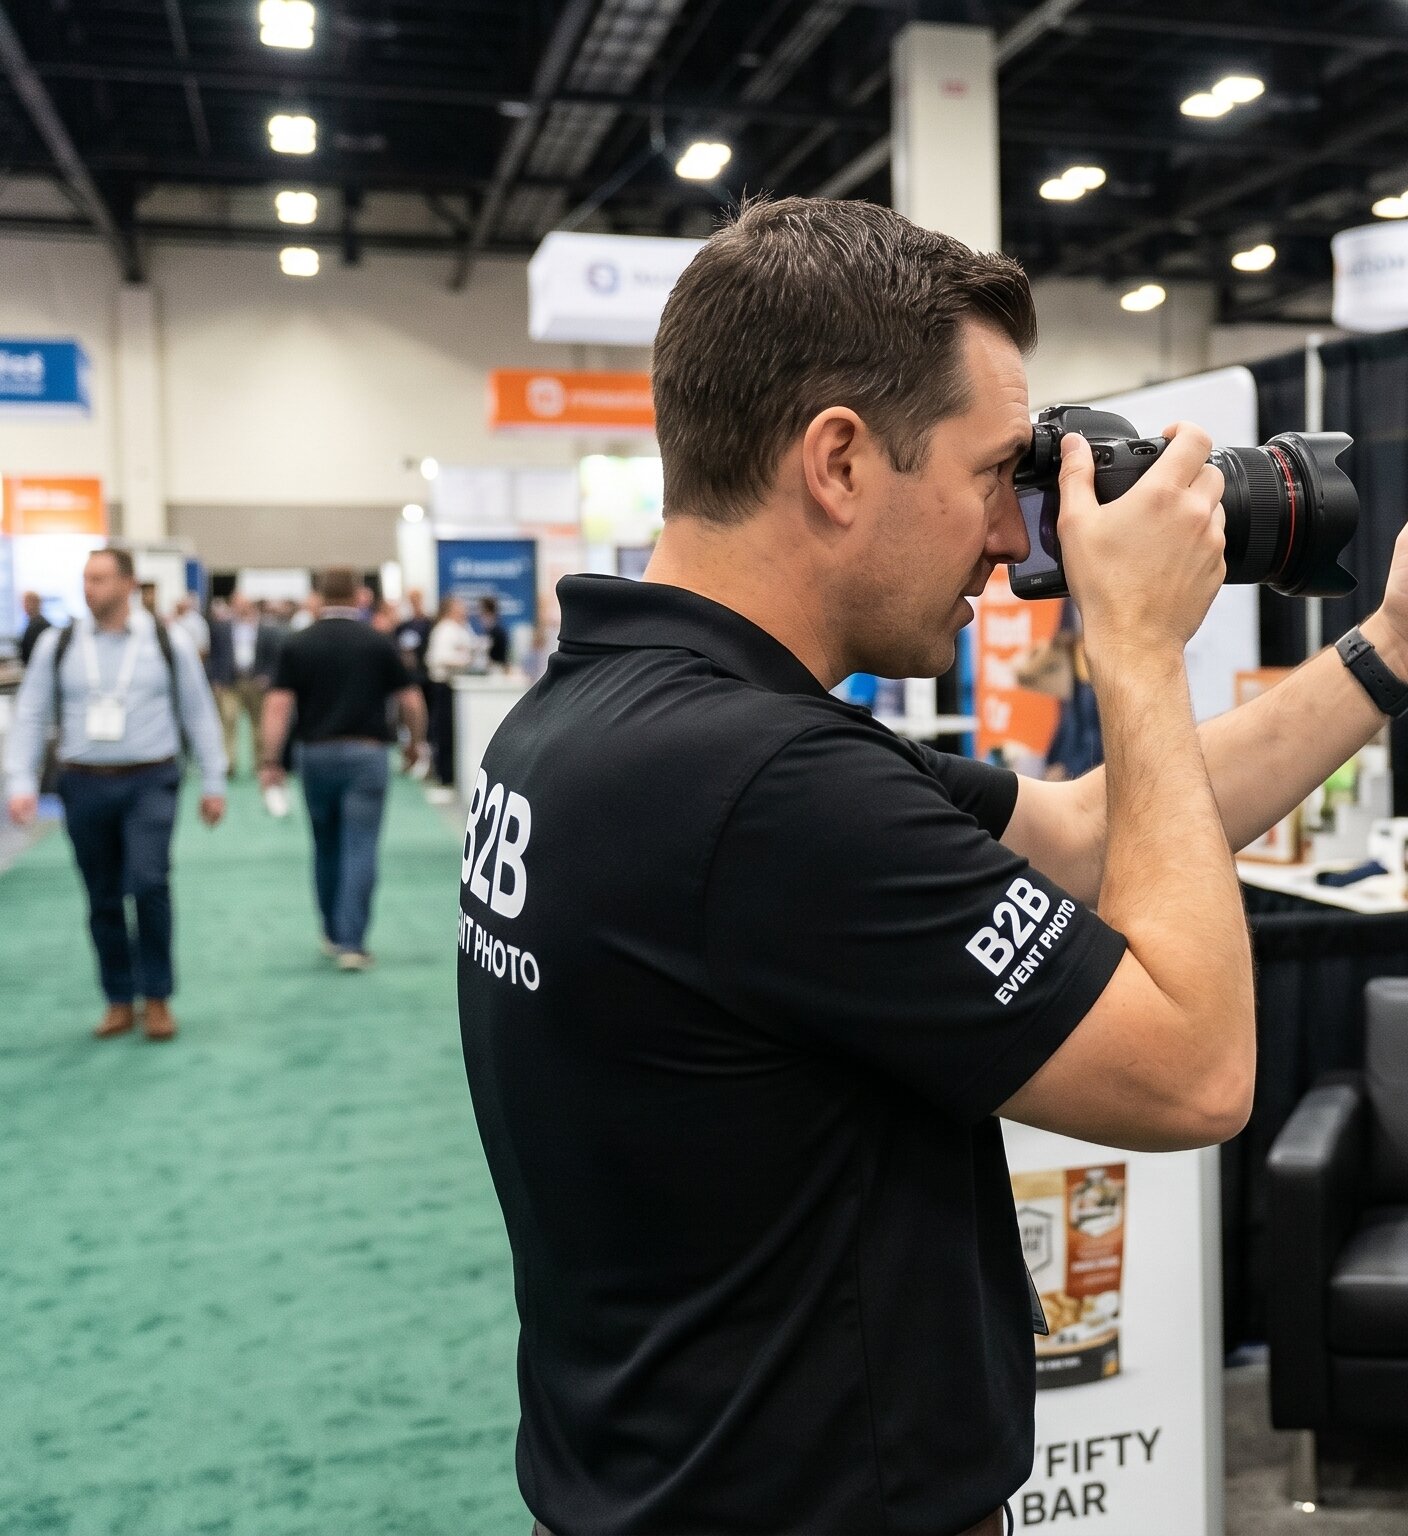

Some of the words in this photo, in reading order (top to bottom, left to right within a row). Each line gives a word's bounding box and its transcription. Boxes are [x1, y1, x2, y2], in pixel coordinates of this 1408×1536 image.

[462, 767, 532, 919] B2B
[474, 923, 540, 991] PHOTO
[965, 877, 1050, 977] B2B
[994, 944, 1045, 1006] EVENT
[1039, 899, 1076, 949] PHOTO
[1046, 1427, 1161, 1478] FIFTY
[1022, 1481, 1107, 1527] BAR
